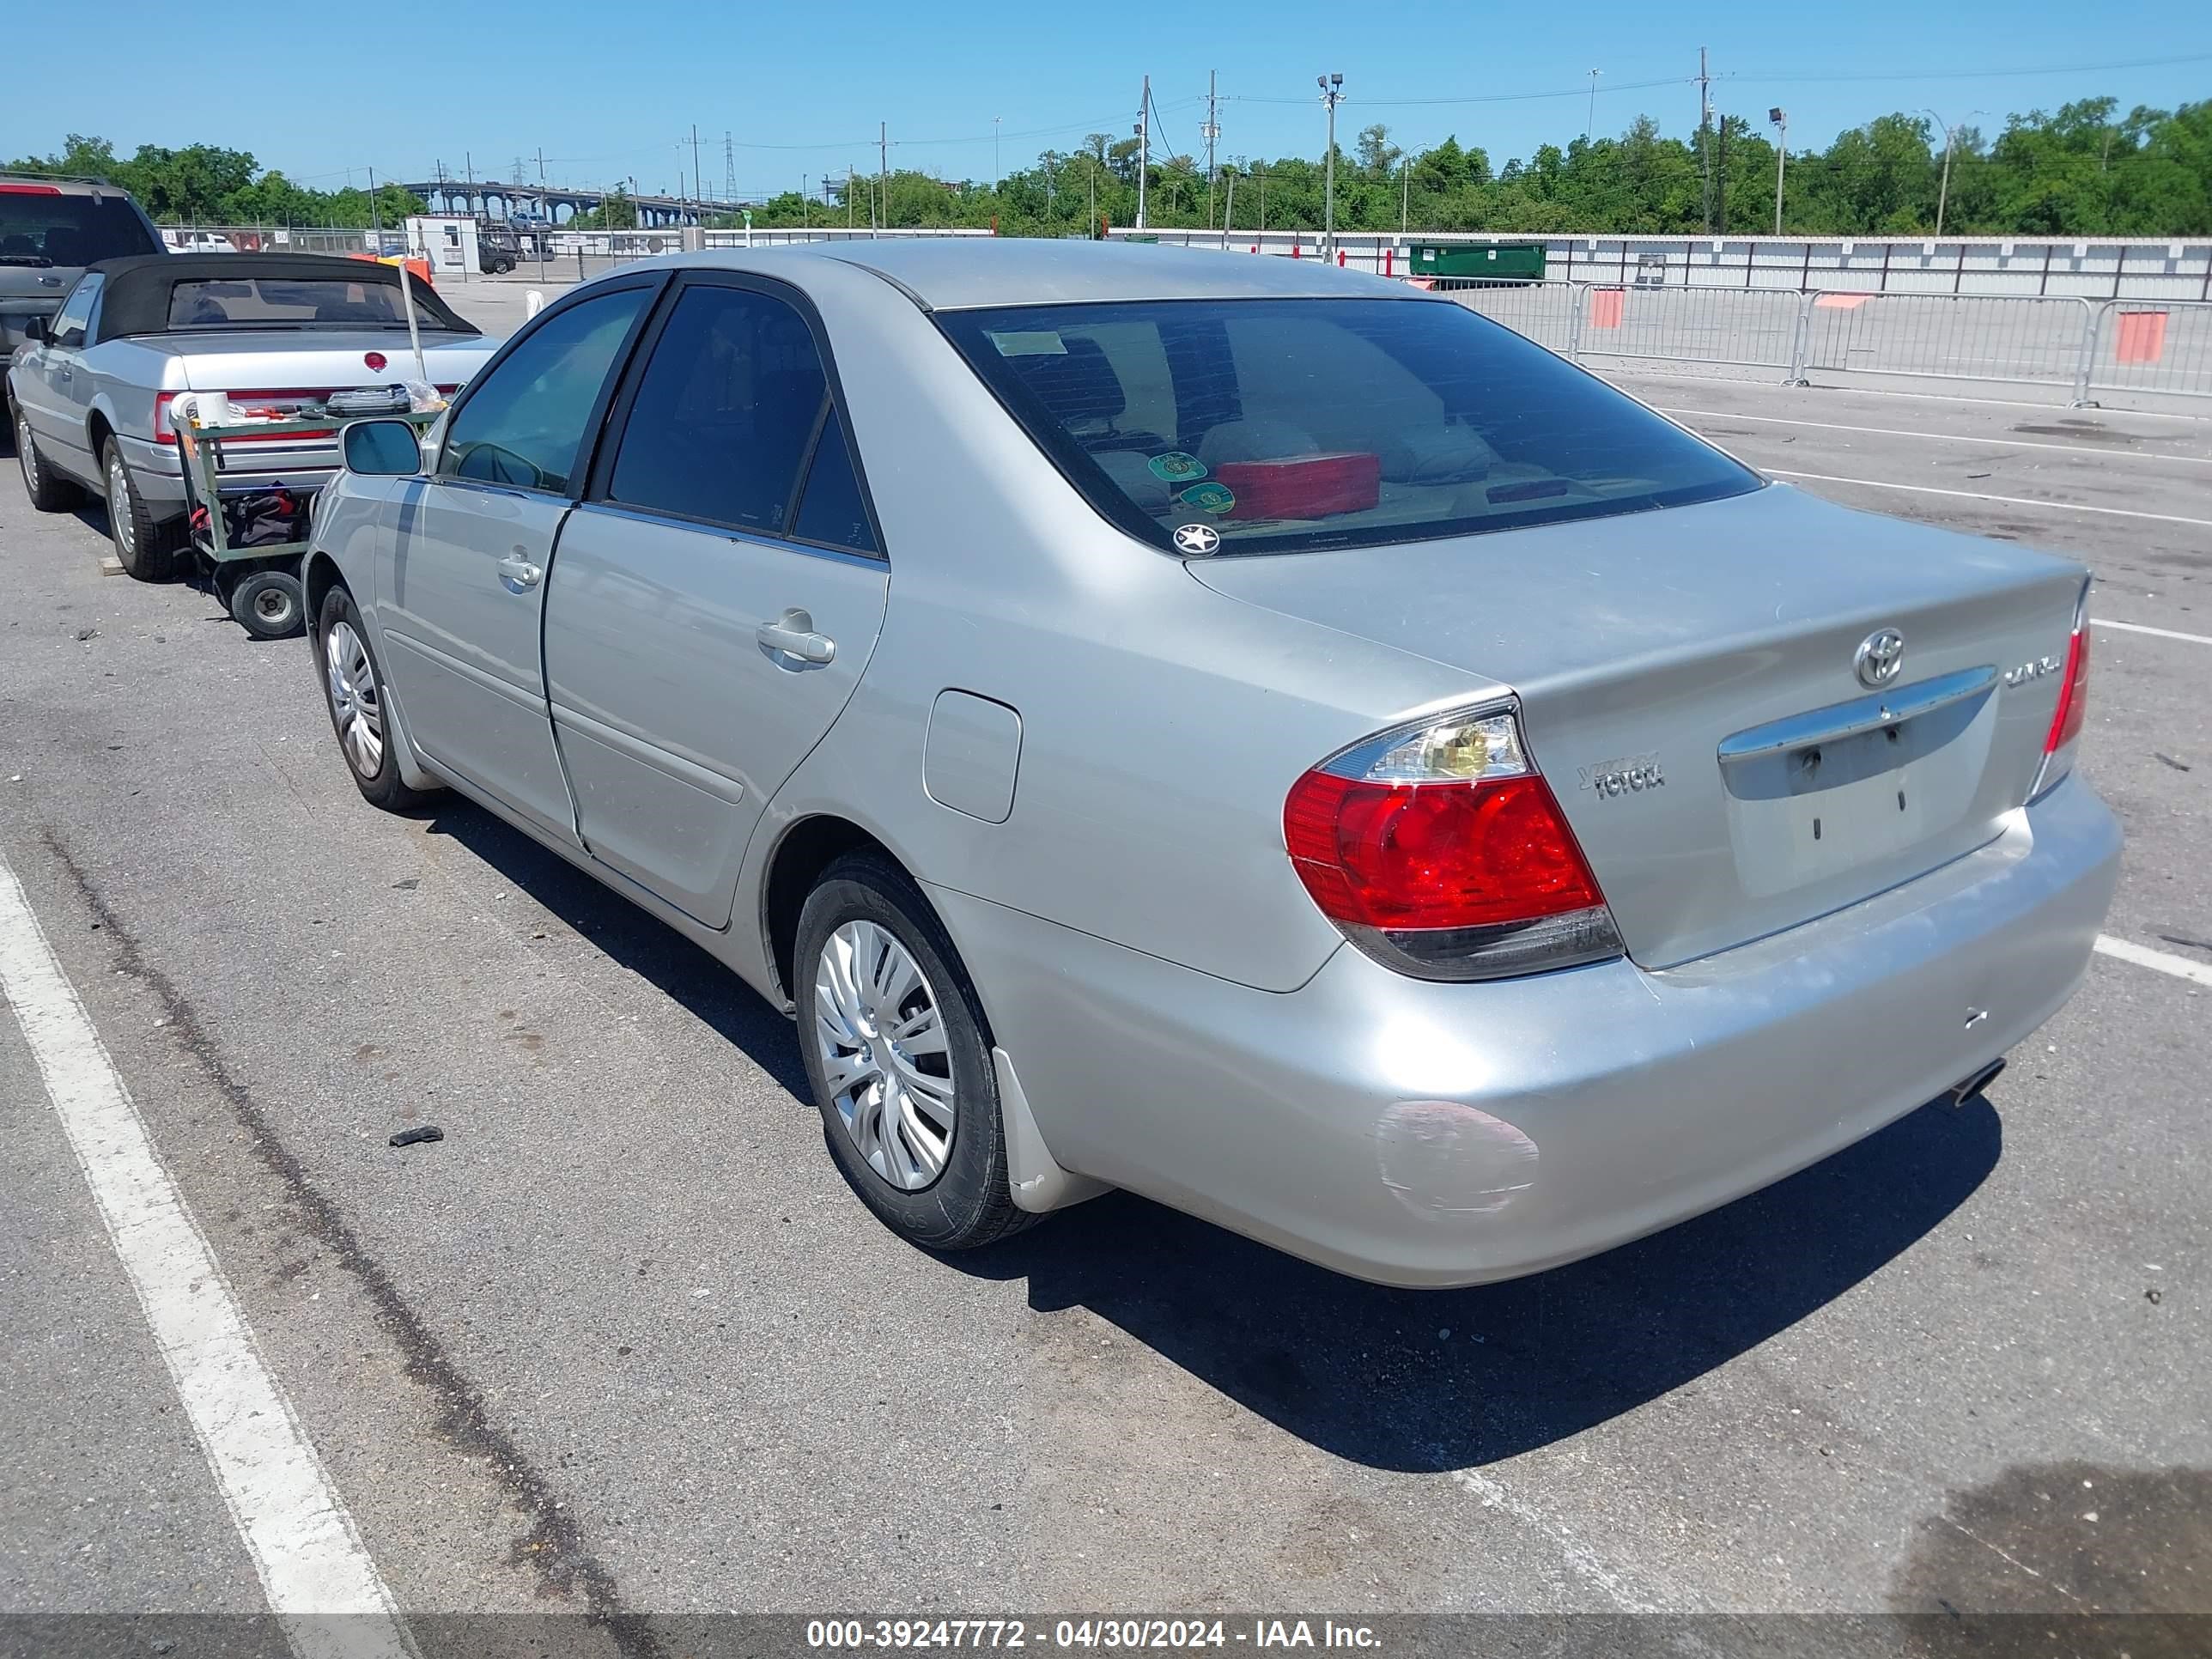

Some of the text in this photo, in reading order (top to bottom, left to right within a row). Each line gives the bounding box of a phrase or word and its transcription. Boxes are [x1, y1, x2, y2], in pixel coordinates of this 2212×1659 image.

[276, 233, 288, 241] 30
[367, 235, 377, 245] 29
[441, 237, 451, 246] 28
[1594, 763, 1665, 800] TOYOTA
